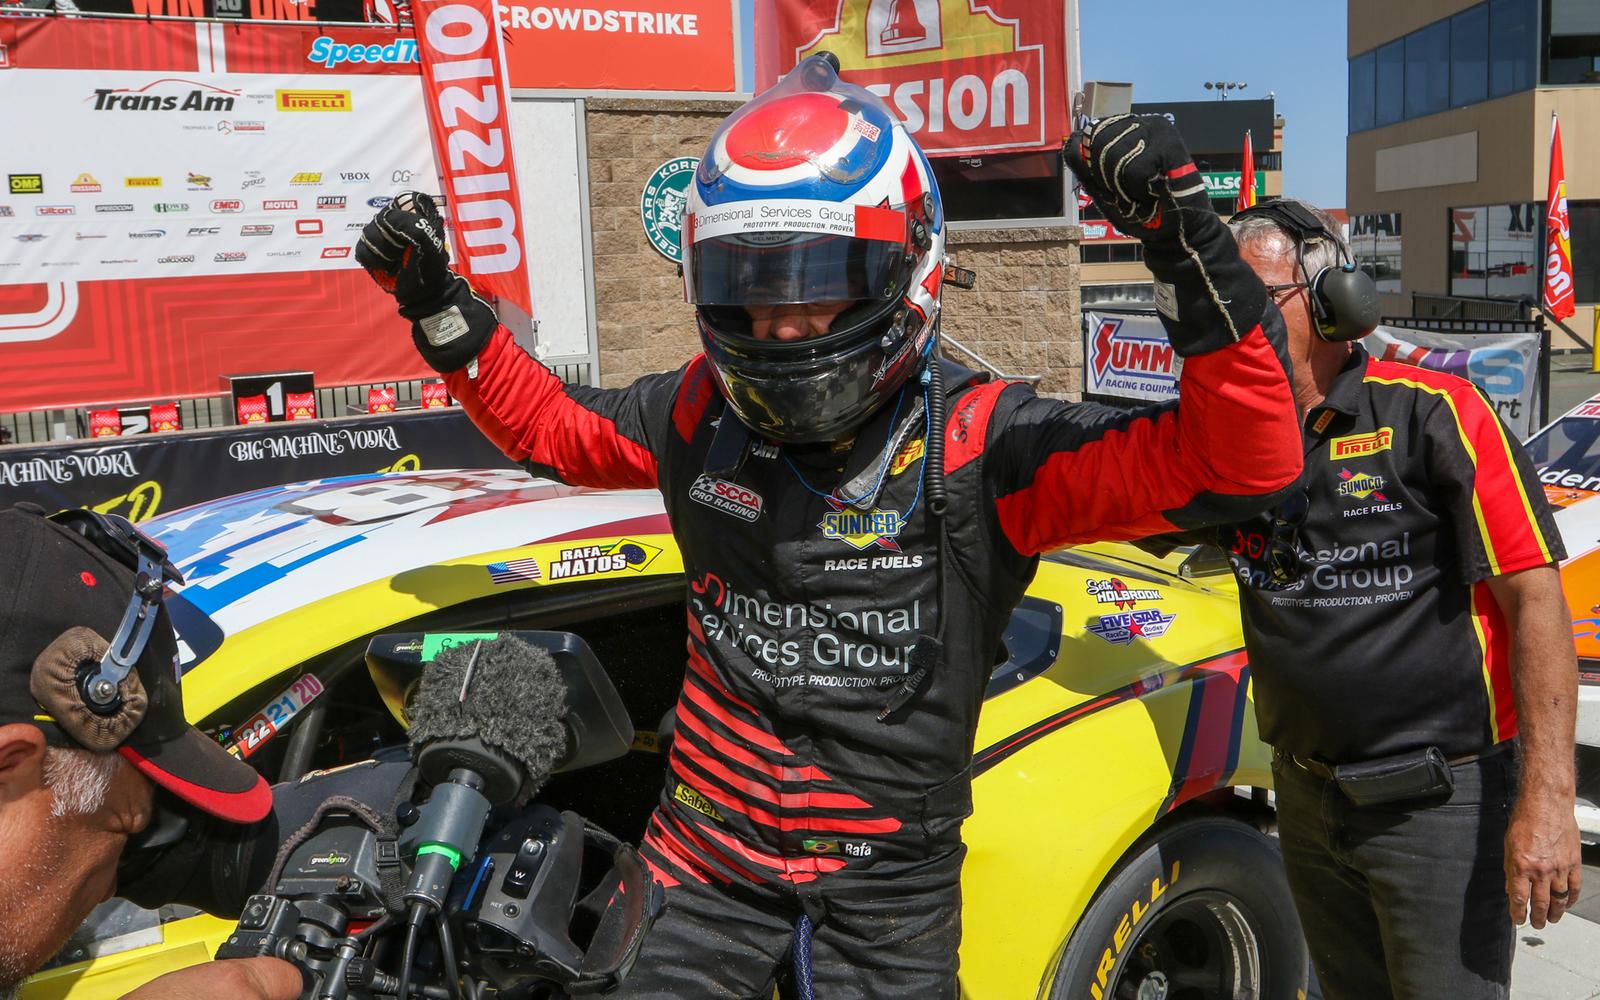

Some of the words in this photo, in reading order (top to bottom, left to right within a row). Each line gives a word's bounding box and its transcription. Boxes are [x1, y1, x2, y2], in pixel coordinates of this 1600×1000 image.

[497, 6, 698, 36] CROWDSTRIKE
[94, 89, 178, 111] Trans
[180, 90, 235, 111] Am
[282, 93, 345, 108] PIRELLI
[11, 178, 40, 190] OMP
[339, 172, 370, 181] VBOX
[264, 201, 296, 209] MOTUL
[760, 206, 812, 218] Services
[818, 207, 855, 223] Group
[1105, 378, 1137, 390] RACING
[266, 381, 284, 416] 1
[229, 440, 265, 462] BIG
[264, 431, 349, 458] MACHINE
[338, 426, 402, 451] VODKA
[1336, 431, 1390, 456] PIRELLI
[0, 457, 73, 487] ACHINE
[66, 450, 140, 477] VODKA
[713, 480, 760, 510] SCCA
[1339, 477, 1383, 496] SUNOCO
[691, 488, 714, 505] PRO
[714, 498, 758, 520] RACING
[1343, 507, 1368, 518] RACE
[1371, 502, 1402, 514] FUELS
[826, 512, 898, 536] SUNOCO
[561, 545, 601, 561] RAFA
[550, 553, 627, 579] MATOS
[824, 558, 868, 572] RACE
[871, 555, 923, 570] FUELS
[1312, 564, 1413, 591] Group
[1097, 589, 1162, 603] HOLBROOK
[1313, 596, 1373, 607] PRODUCTION.
[1374, 590, 1414, 603] PROVEN
[1101, 614, 1130, 631] FIVE
[1132, 610, 1163, 624] STAR
[808, 675, 878, 688] PRODUCTION.
[266, 695, 297, 726] 21
[291, 673, 321, 705] 20
[845, 842, 872, 857] Rafa
[514, 870, 526, 879] W
